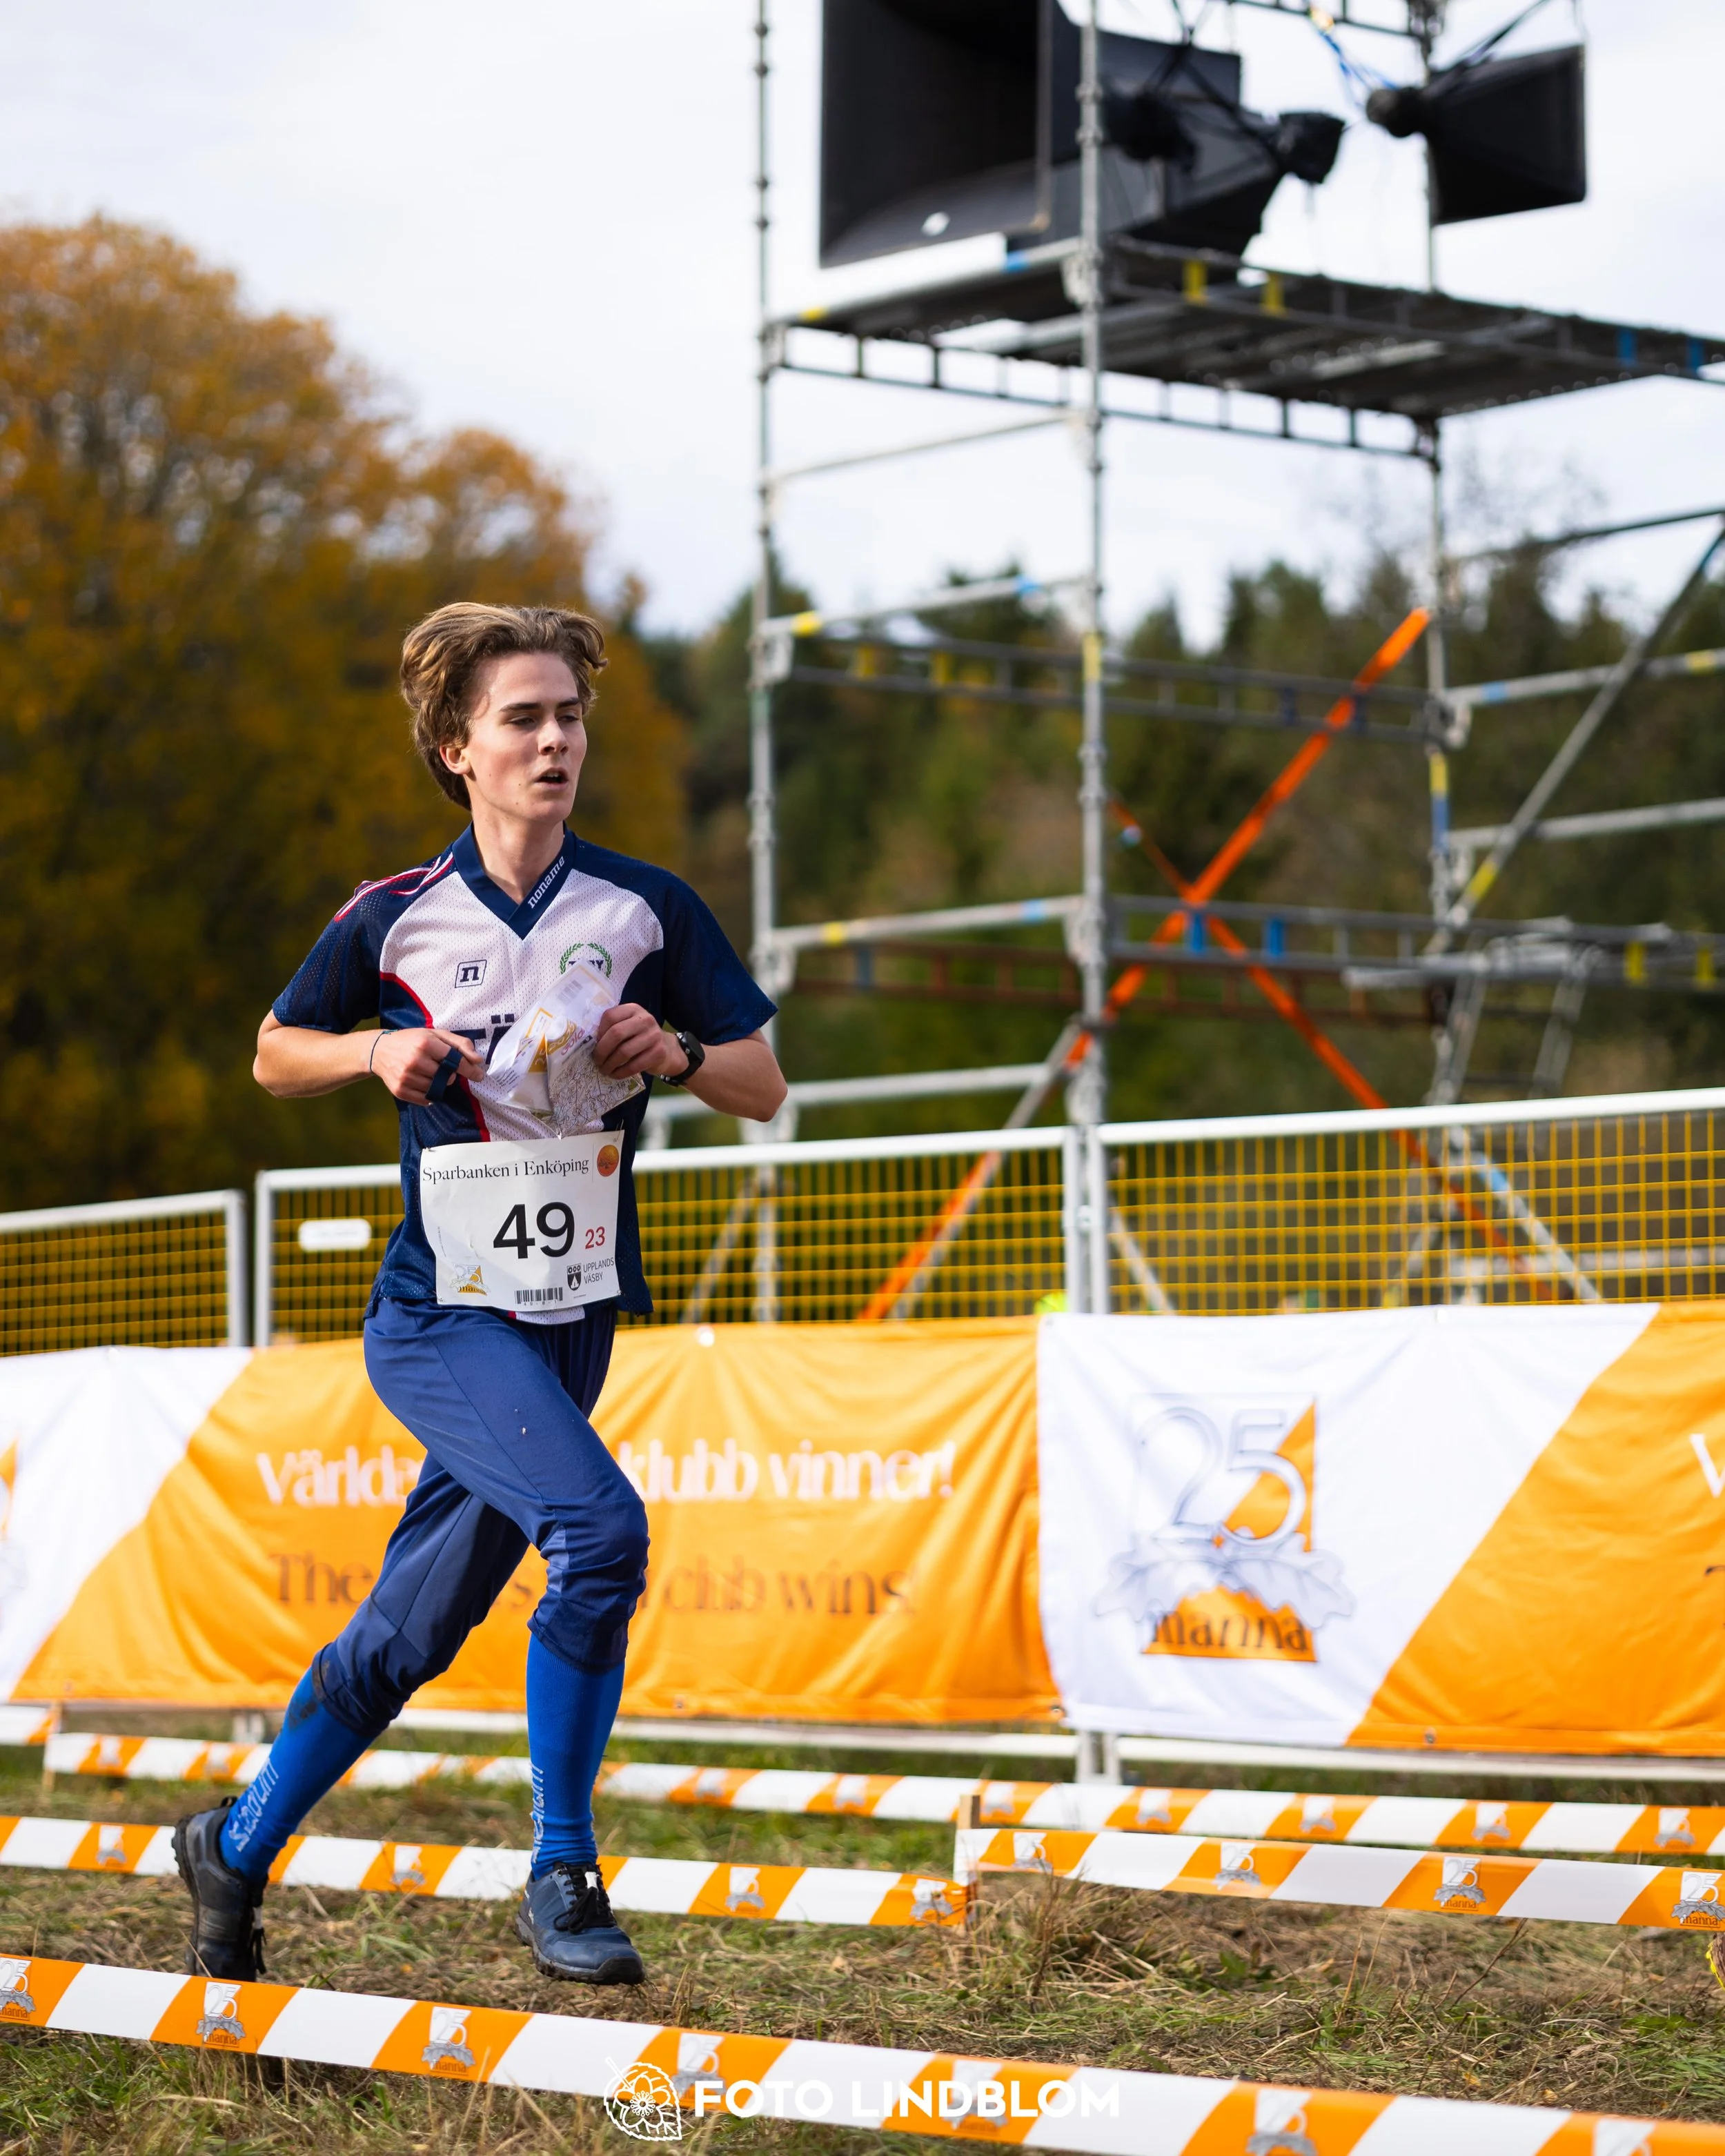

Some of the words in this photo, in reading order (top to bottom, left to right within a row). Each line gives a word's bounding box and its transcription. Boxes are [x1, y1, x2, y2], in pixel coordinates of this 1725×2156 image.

[528, 856, 564, 909] noname
[423, 1164, 509, 1185] Sparbanken
[515, 1163, 519, 1176] i
[524, 1159, 589, 1176] Enköping
[493, 1201, 575, 1259] 49
[585, 1226, 605, 1249] 23
[583, 1257, 615, 1273] UPPLANDS
[584, 1272, 604, 1284] VÄSBY
[767, 1439, 956, 1500] vinner!
[1137, 1406, 1308, 1547] 25
[268, 1550, 374, 1608] The
[1446, 1858, 1478, 1888] 25
[1684, 1874, 1719, 1904] 25
[0, 1960, 28, 1994] 25
[207, 1985, 238, 2020] 25
[433, 2010, 467, 2047] 25
